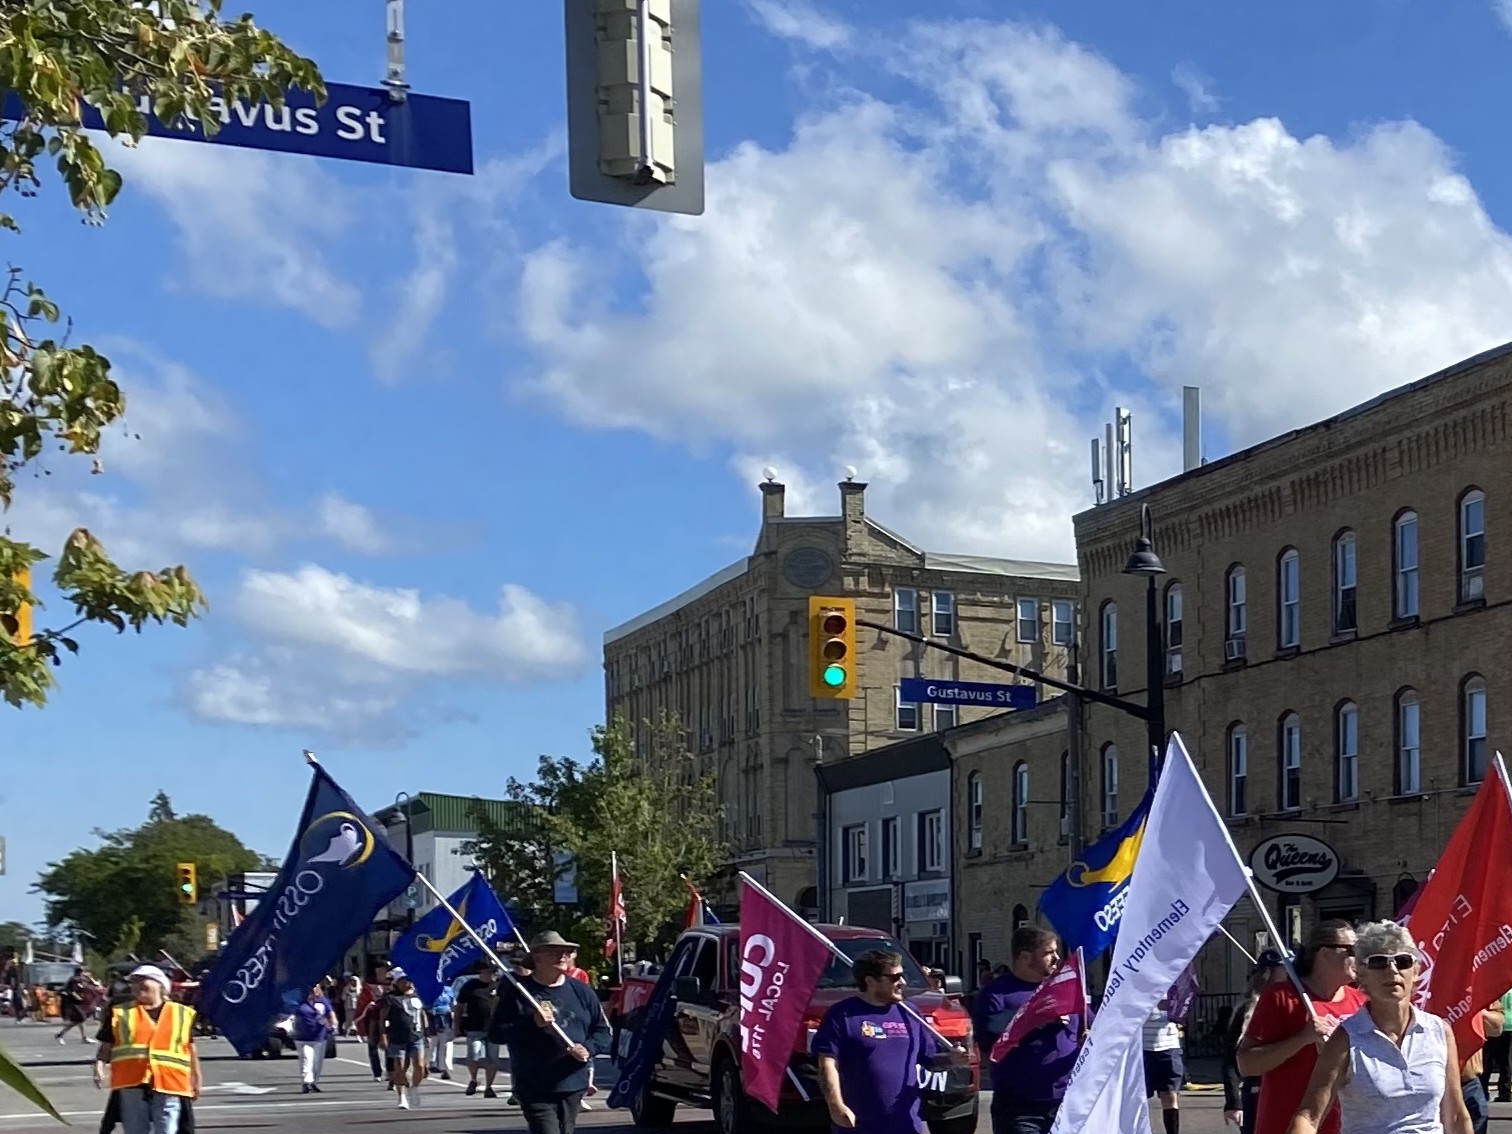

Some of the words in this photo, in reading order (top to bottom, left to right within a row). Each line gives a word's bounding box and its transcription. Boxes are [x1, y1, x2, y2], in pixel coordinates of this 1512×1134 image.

[336, 106, 386, 145] St
[926, 685, 993, 701] Gustavus
[996, 690, 1012, 702] St
[1264, 843, 1329, 871] Queens
